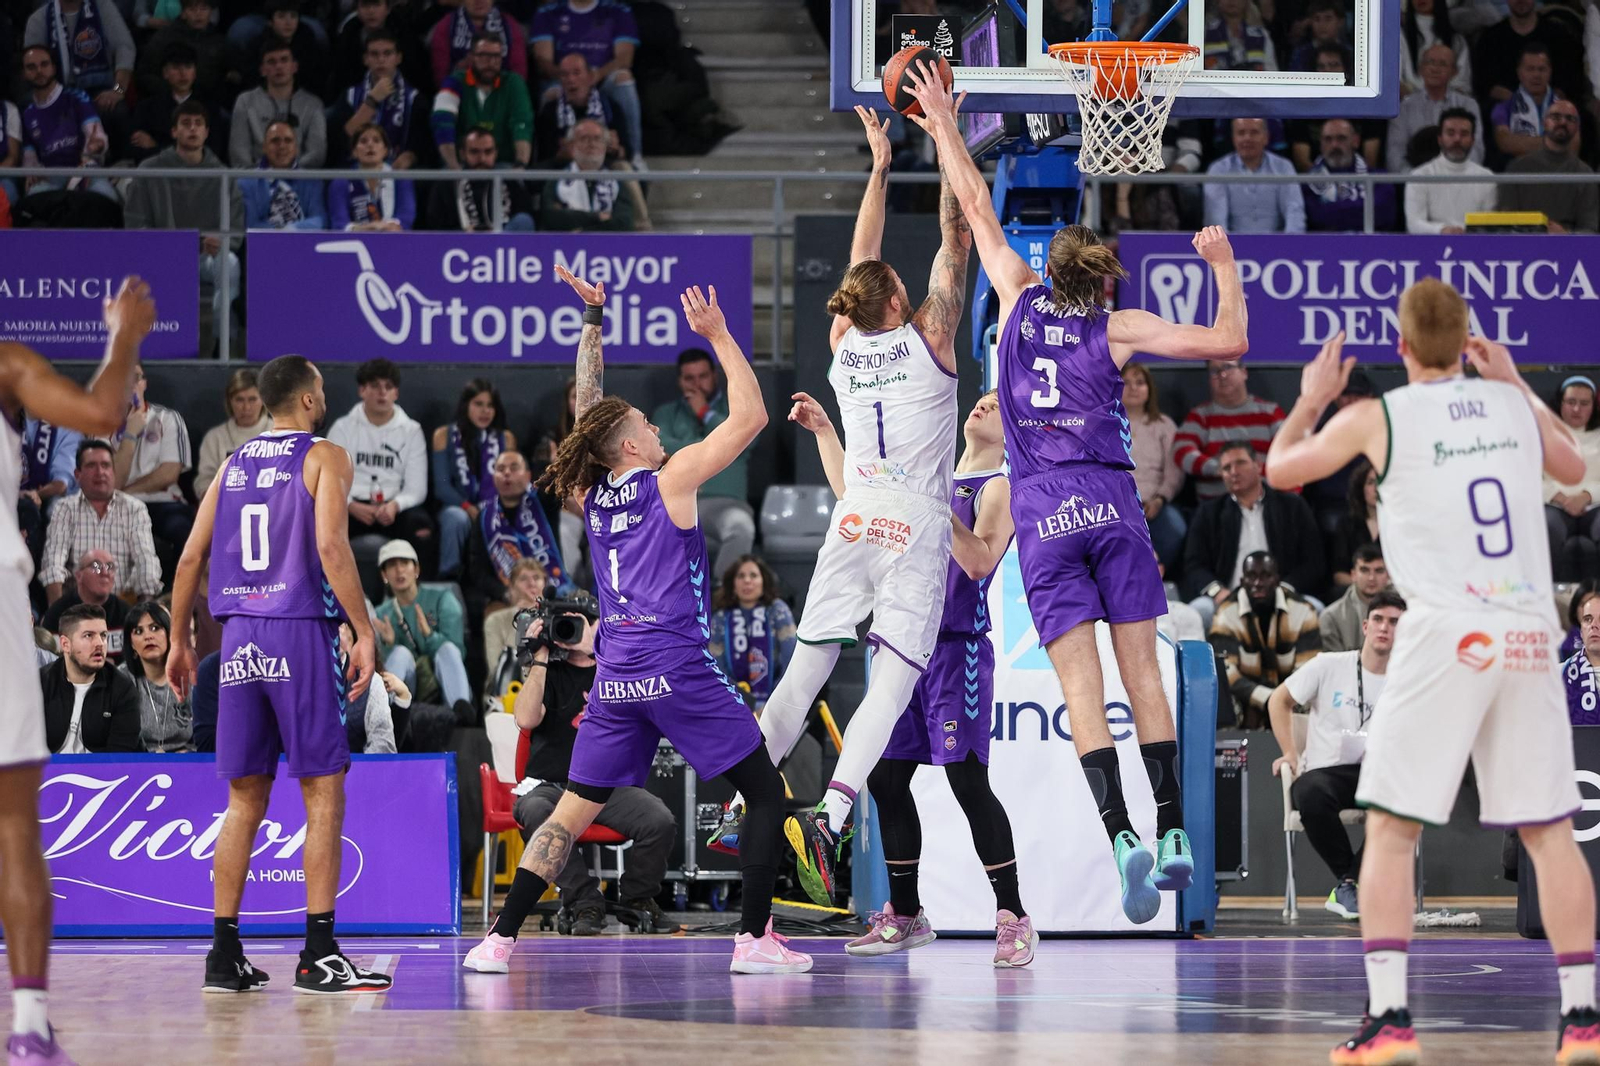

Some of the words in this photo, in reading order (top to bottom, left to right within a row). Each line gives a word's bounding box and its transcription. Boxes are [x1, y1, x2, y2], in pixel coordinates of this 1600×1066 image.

[901, 32, 915, 40] liga
[901, 39, 930, 47] endesa
[442, 247, 543, 284] Calle
[553, 249, 678, 292] Mayor
[1065, 334, 1080, 344] Dip
[1030, 357, 1060, 408] 3
[873, 401, 886, 459] 1
[1062, 416, 1085, 426] LEÓN
[356, 452, 394, 468] PUMA
[276, 471, 292, 482] Dip
[628, 514, 643, 524] Dip
[871, 518, 911, 536] COSTA
[1036, 503, 1120, 539] LEBANZA
[1468, 477, 1513, 558] 9
[241, 504, 269, 571] 0
[867, 527, 886, 538] DEL
[888, 531, 908, 546] SOL
[608, 549, 628, 603] 1
[220, 657, 291, 684] LEBANZA
[599, 675, 672, 699] LEBANZA
